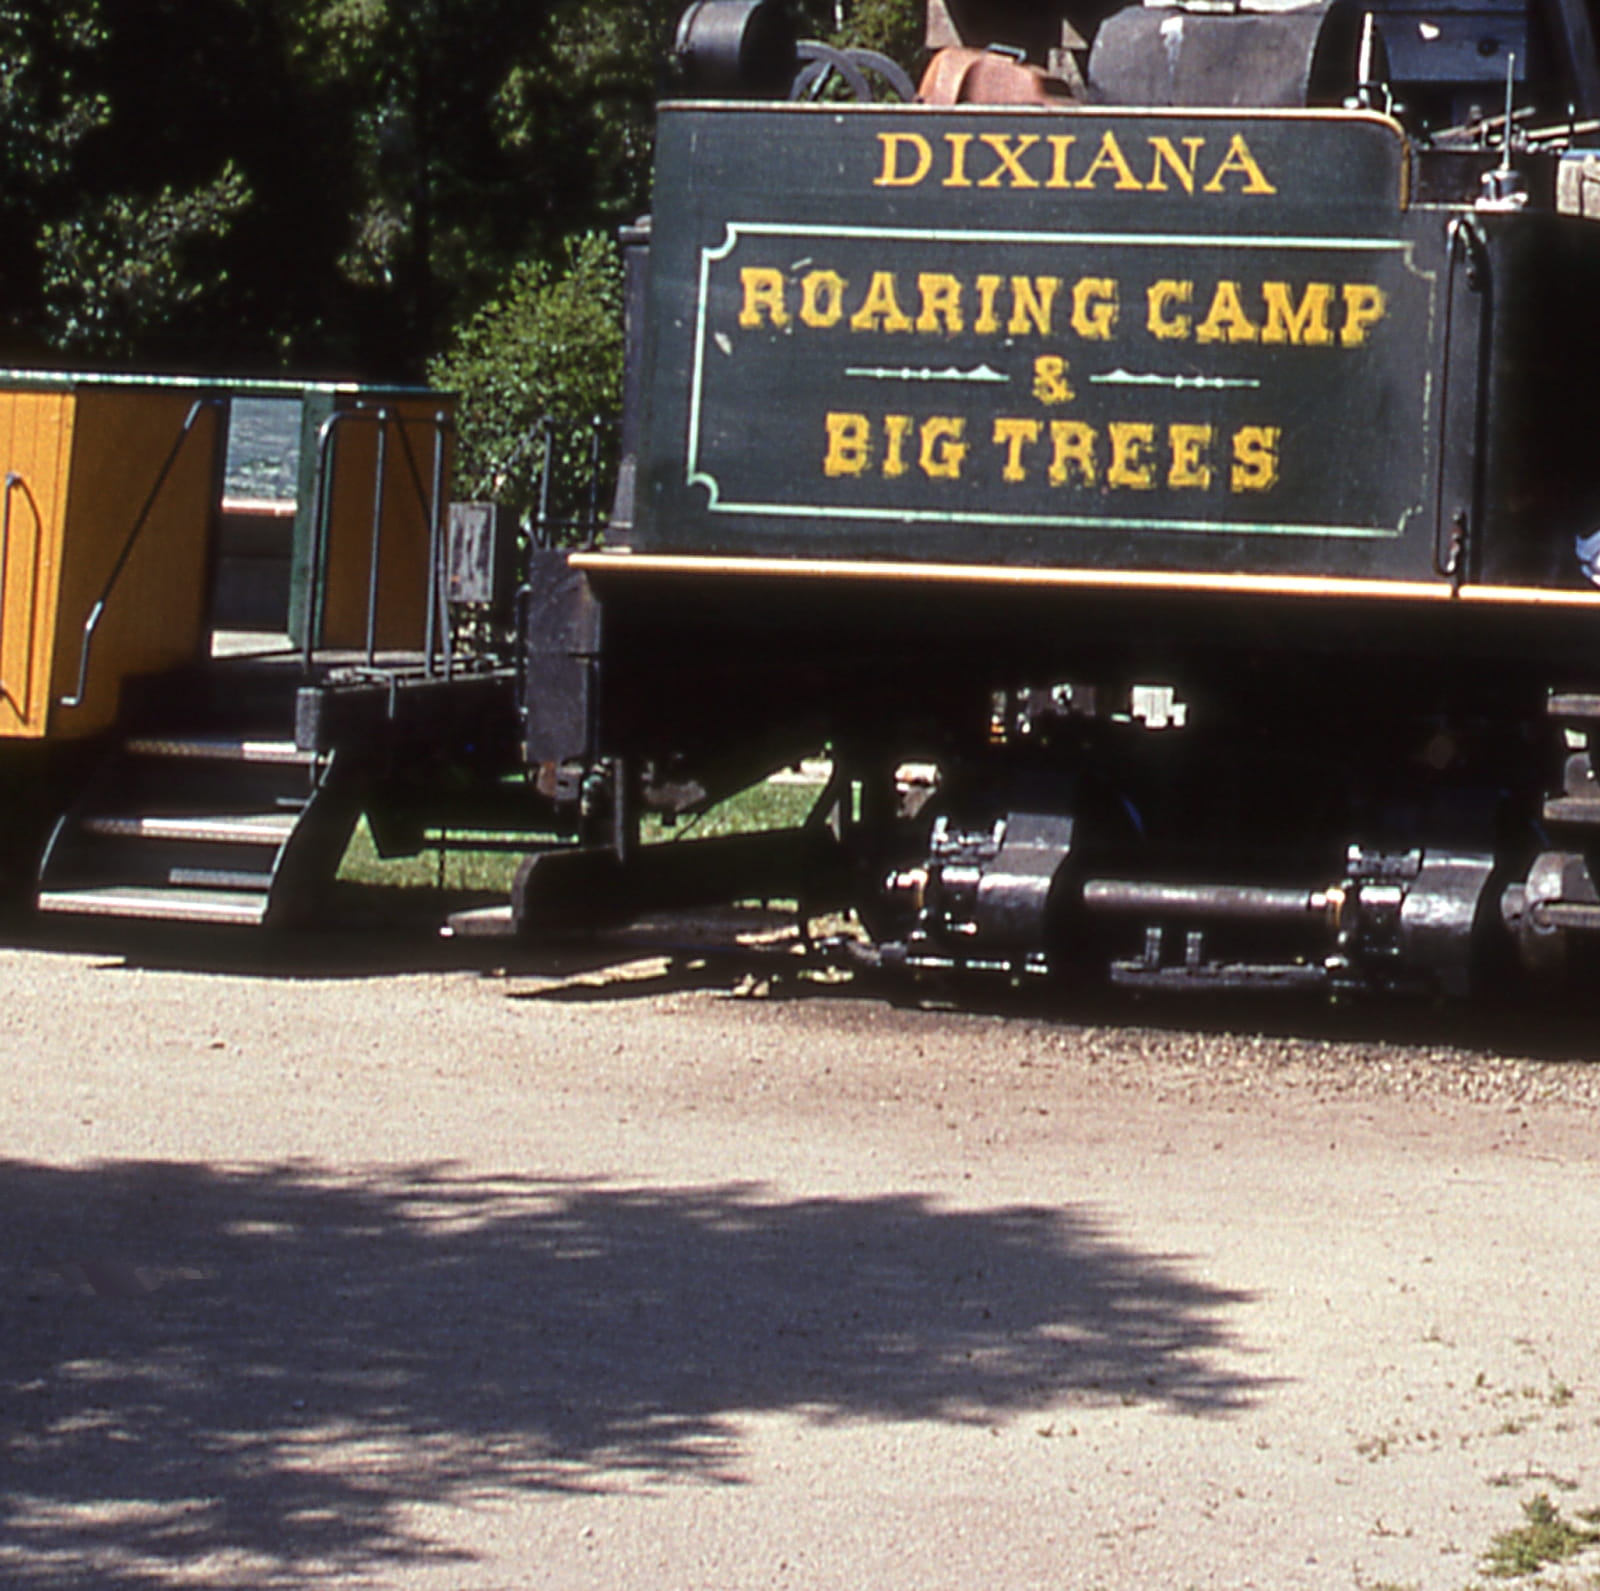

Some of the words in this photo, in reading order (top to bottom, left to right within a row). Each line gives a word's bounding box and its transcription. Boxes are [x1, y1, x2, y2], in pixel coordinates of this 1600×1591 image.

[873, 130, 1277, 194] DIXIANA
[738, 267, 1120, 340] ROARING
[1147, 279, 1387, 348] CAMP
[1032, 355, 1076, 404] &
[823, 412, 969, 480] BIG
[992, 417, 1282, 491] TREES
